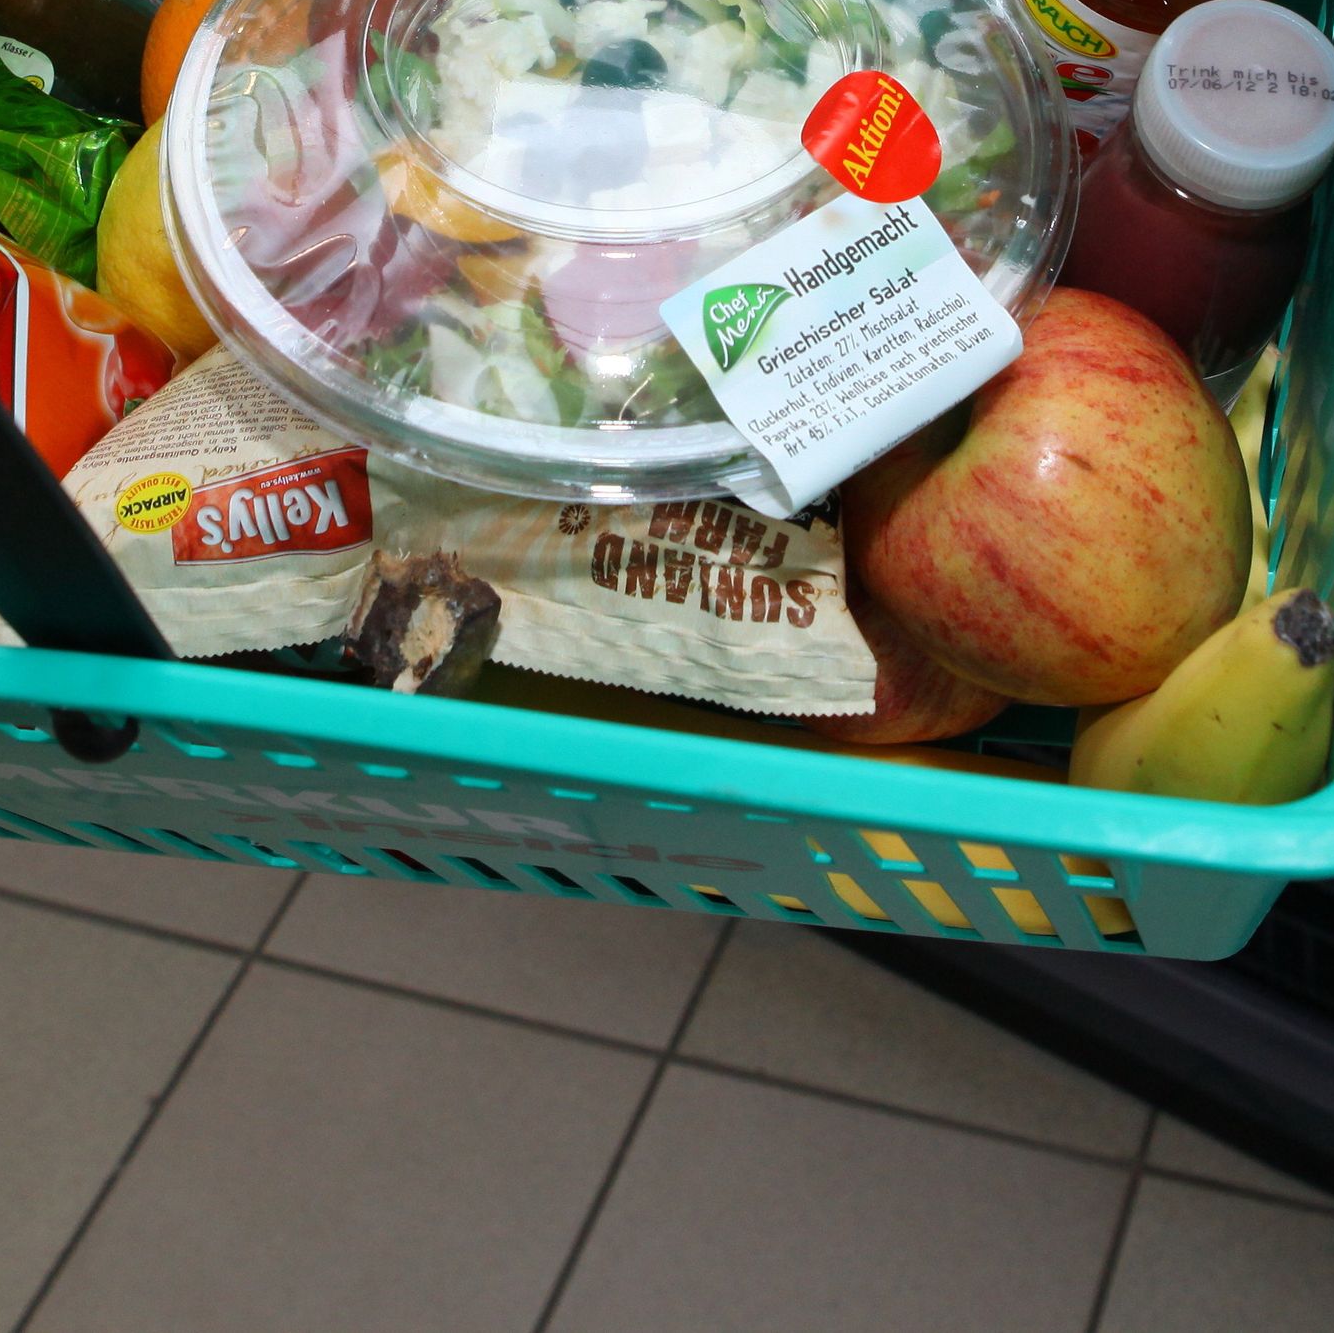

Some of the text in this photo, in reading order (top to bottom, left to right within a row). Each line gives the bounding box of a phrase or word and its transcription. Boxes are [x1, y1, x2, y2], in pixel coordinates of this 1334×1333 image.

[0, 41, 29, 59] Klasse
[1166, 64, 1320, 86] Trink mich bis
[1167, 77, 1257, 93] 07/06/12
[1267, 82, 1279, 94] 2
[841, 77, 905, 191] Aktion!
[782, 204, 920, 298] Handgemacht
[709, 288, 750, 325] Chef
[757, 266, 920, 376] Griechischer Salat
[783, 295, 921, 390] Zutaten: 27% Mischsalat
[747, 390, 815, 435] (Zuckerhut,
[812, 359, 865, 398] Endivien,
[862, 327, 916, 365] Karotten,
[913, 292, 971, 333] Radicchio),
[762, 311, 980, 447] Paprika, 23% Weißkäse nach griechischer
[225, 393, 267, 404] Packung
[783, 434, 808, 459] Art
[808, 420, 835, 443] 45%
[863, 349, 959, 410] Cocktailtomaten,
[955, 324, 996, 353] Oliven.
[201, 403, 235, 413] A-1220
[225, 409, 248, 419] Kelly
[268, 408, 289, 416] bitte
[170, 425, 191, 433] oder
[178, 432, 201, 441] nicht
[203, 429, 235, 438] einmal
[239, 426, 257, 435] das
[260, 424, 288, 433] Sollte
[159, 434, 175, 443] der
[222, 436, 238, 445] Sie
[243, 433, 272, 443] sollen
[113, 448, 200, 464] Qualitätsgarantie:
[204, 445, 237, 455] Kelly's
[81, 459, 110, 470] Kelly's
[259, 467, 322, 490] www.kellys.eu
[126, 476, 181, 502] BEST QUALITY
[121, 488, 187, 518] AIRPACK
[130, 505, 183, 529] FRESH TASTE
[196, 478, 350, 554] Kelly's
[646, 500, 791, 569] FARM
[591, 530, 816, 630] SUNLAND
